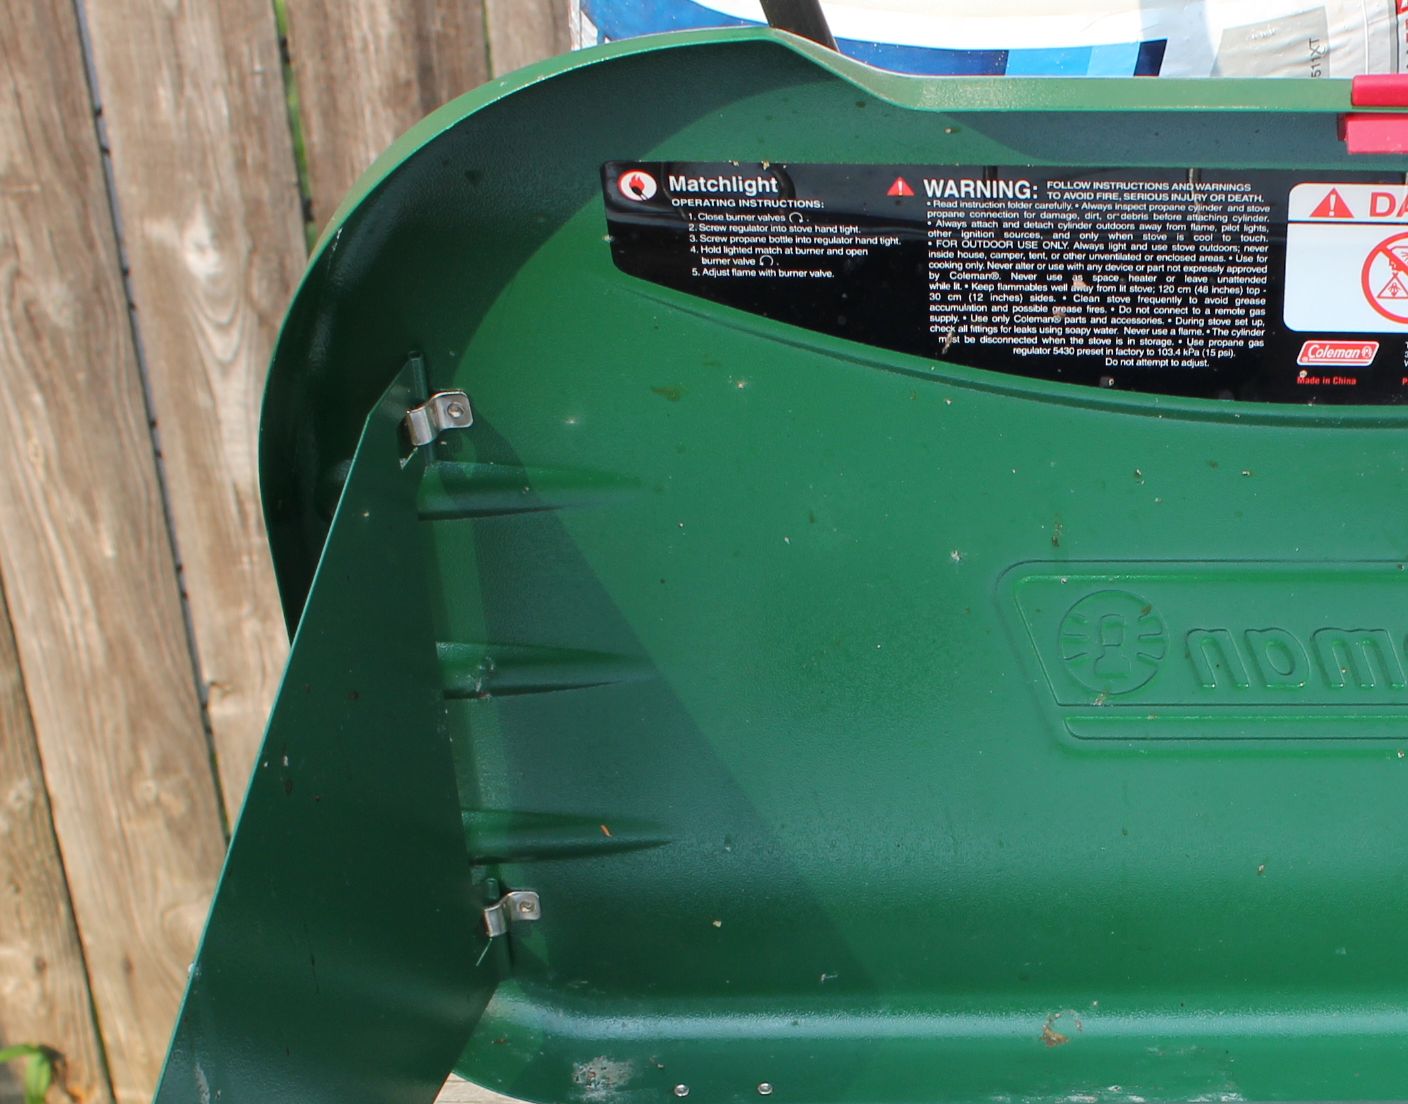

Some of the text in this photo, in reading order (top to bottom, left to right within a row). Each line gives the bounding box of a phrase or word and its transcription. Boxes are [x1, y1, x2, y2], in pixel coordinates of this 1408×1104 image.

[668, 176, 778, 197] Matchlight
[923, 180, 1037, 199] WARNING:
[1047, 181, 1251, 192] FOLLOW INSTRUCTIONS AND WARNINGS
[1047, 192, 1264, 202] TO AVOID FIRE, SERIOUS INJURY OR DEATH.
[671, 199, 823, 208] OPERATING INSTRUCTIONS:
[697, 213, 723, 221] Close
[725, 213, 755, 222] burner
[757, 214, 785, 222] valves
[698, 224, 726, 232] Screw
[729, 224, 768, 234] regulator
[770, 225, 787, 233] into
[789, 225, 812, 233] stove
[814, 225, 837, 233] hand
[839, 226, 860, 235] tight.
[699, 235, 727, 243] Screw
[729, 237, 766, 245] propane
[768, 235, 793, 244] bottle
[795, 236, 811, 244] into
[813, 236, 853, 246] regulator
[854, 236, 878, 244] hand
[879, 237, 901, 246] tight.
[700, 246, 721, 254] Hold
[723, 246, 752, 256] lighted
[754, 246, 782, 255] match
[795, 247, 824, 255] burner
[826, 247, 843, 255] and
[701, 257, 755, 265] burner valve
[702, 268, 730, 278] Adjust
[731, 269, 756, 277] flame
[758, 269, 776, 277] with
[778, 269, 807, 277] burner
[809, 269, 834, 277] valve.
[1308, 344, 1360, 359] Coleman
[1105, 358, 1209, 369] Do not attempt to adjust.
[1297, 376, 1319, 385] Made
[1332, 377, 1356, 385] China
